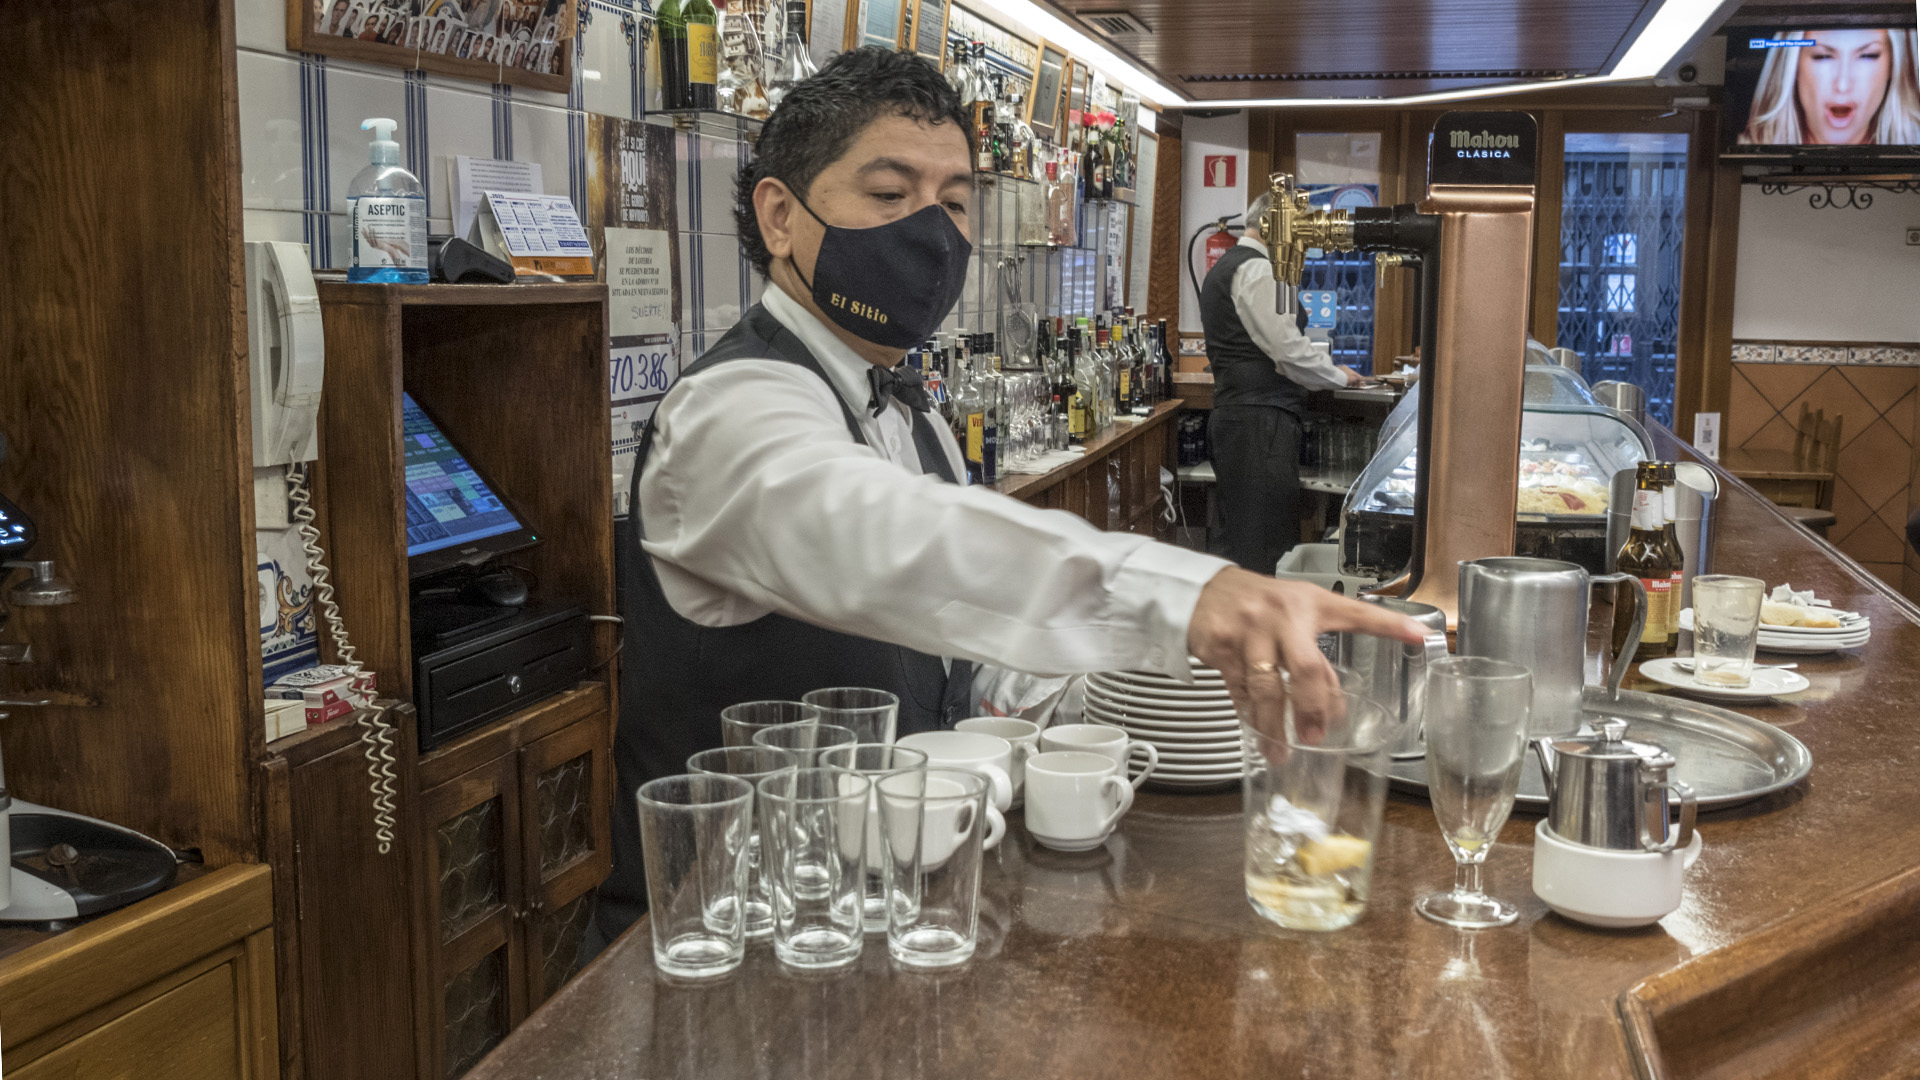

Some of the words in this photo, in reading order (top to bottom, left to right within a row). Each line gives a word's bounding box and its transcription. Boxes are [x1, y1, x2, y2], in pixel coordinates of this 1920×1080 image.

[1449, 129, 1520, 148] Mahou
[1457, 149, 1511, 158] CLÁSICA
[368, 204, 405, 216] ASEPTIC
[830, 293, 846, 309] El
[850, 301, 888, 325] Sitio
